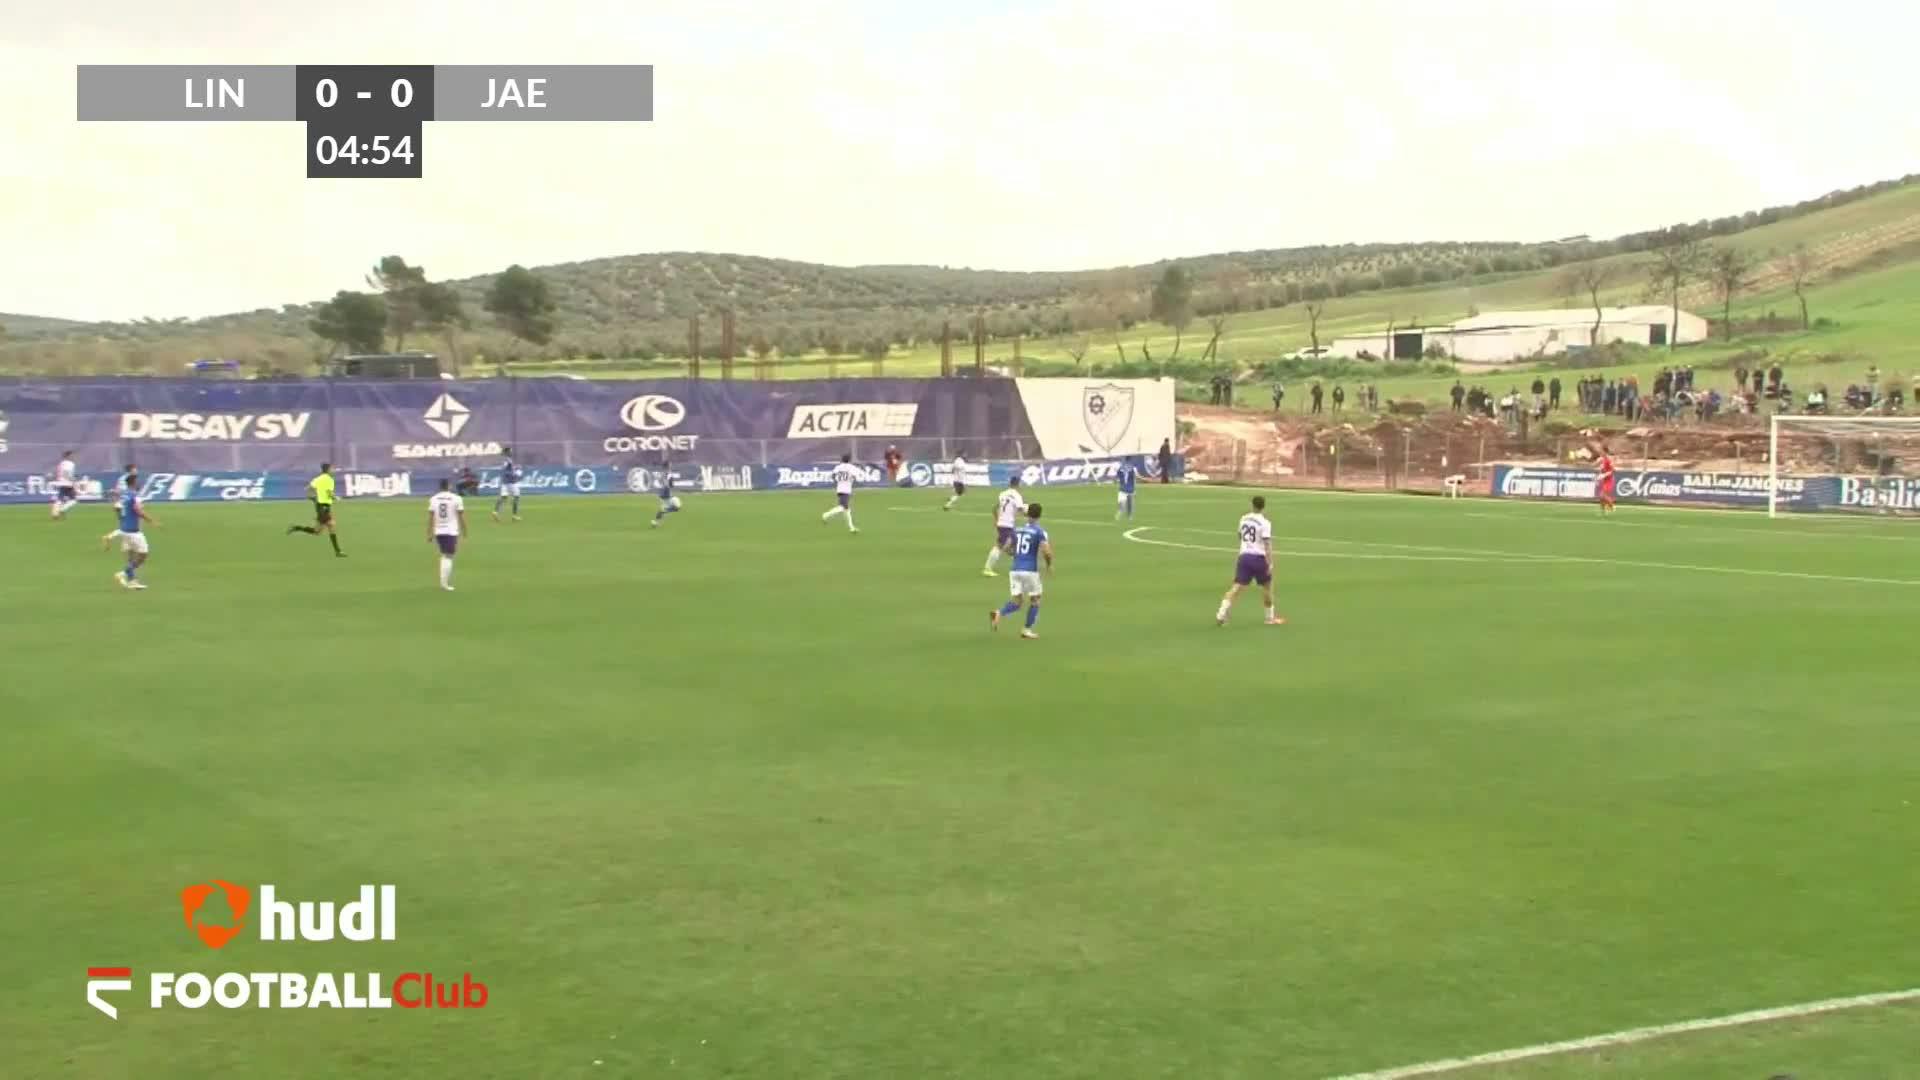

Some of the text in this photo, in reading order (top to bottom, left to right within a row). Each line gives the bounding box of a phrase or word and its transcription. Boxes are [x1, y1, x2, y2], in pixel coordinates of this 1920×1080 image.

[119, 412, 310, 440] DESAY SV
[798, 410, 868, 432] ACTIA
[393, 442, 502, 458] SANTANA
[603, 435, 699, 452] CORONET
[1016, 533, 1031, 554] 15
[1242, 524, 1256, 543] 29
